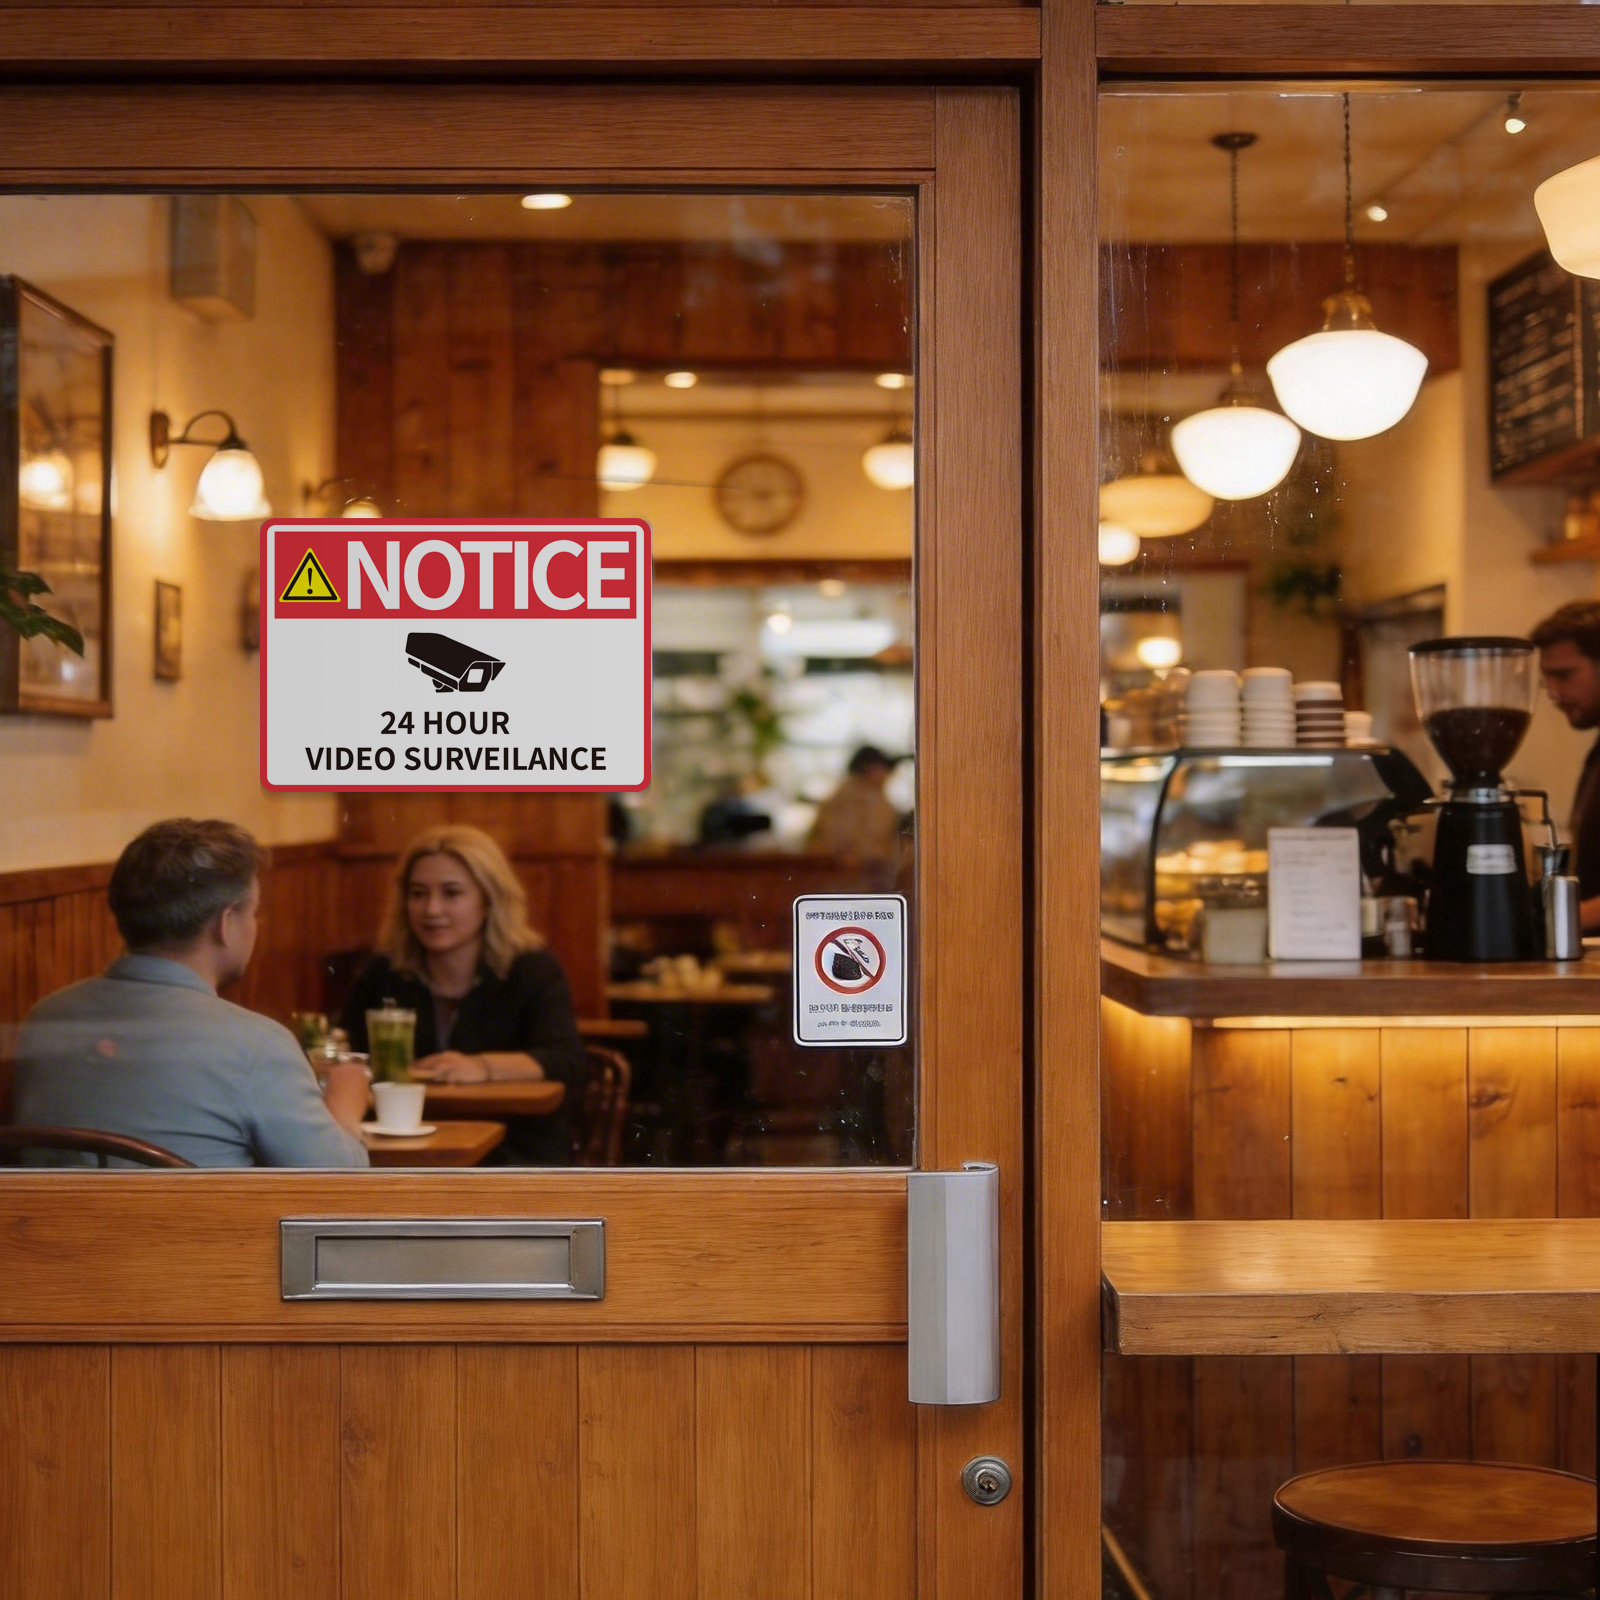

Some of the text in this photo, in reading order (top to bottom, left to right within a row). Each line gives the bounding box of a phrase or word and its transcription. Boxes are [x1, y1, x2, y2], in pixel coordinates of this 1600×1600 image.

[347, 540, 631, 611] NOTICE
[380, 711, 510, 735] 24 HOUR
[305, 746, 607, 771] VIDEO SURVEILANCE
